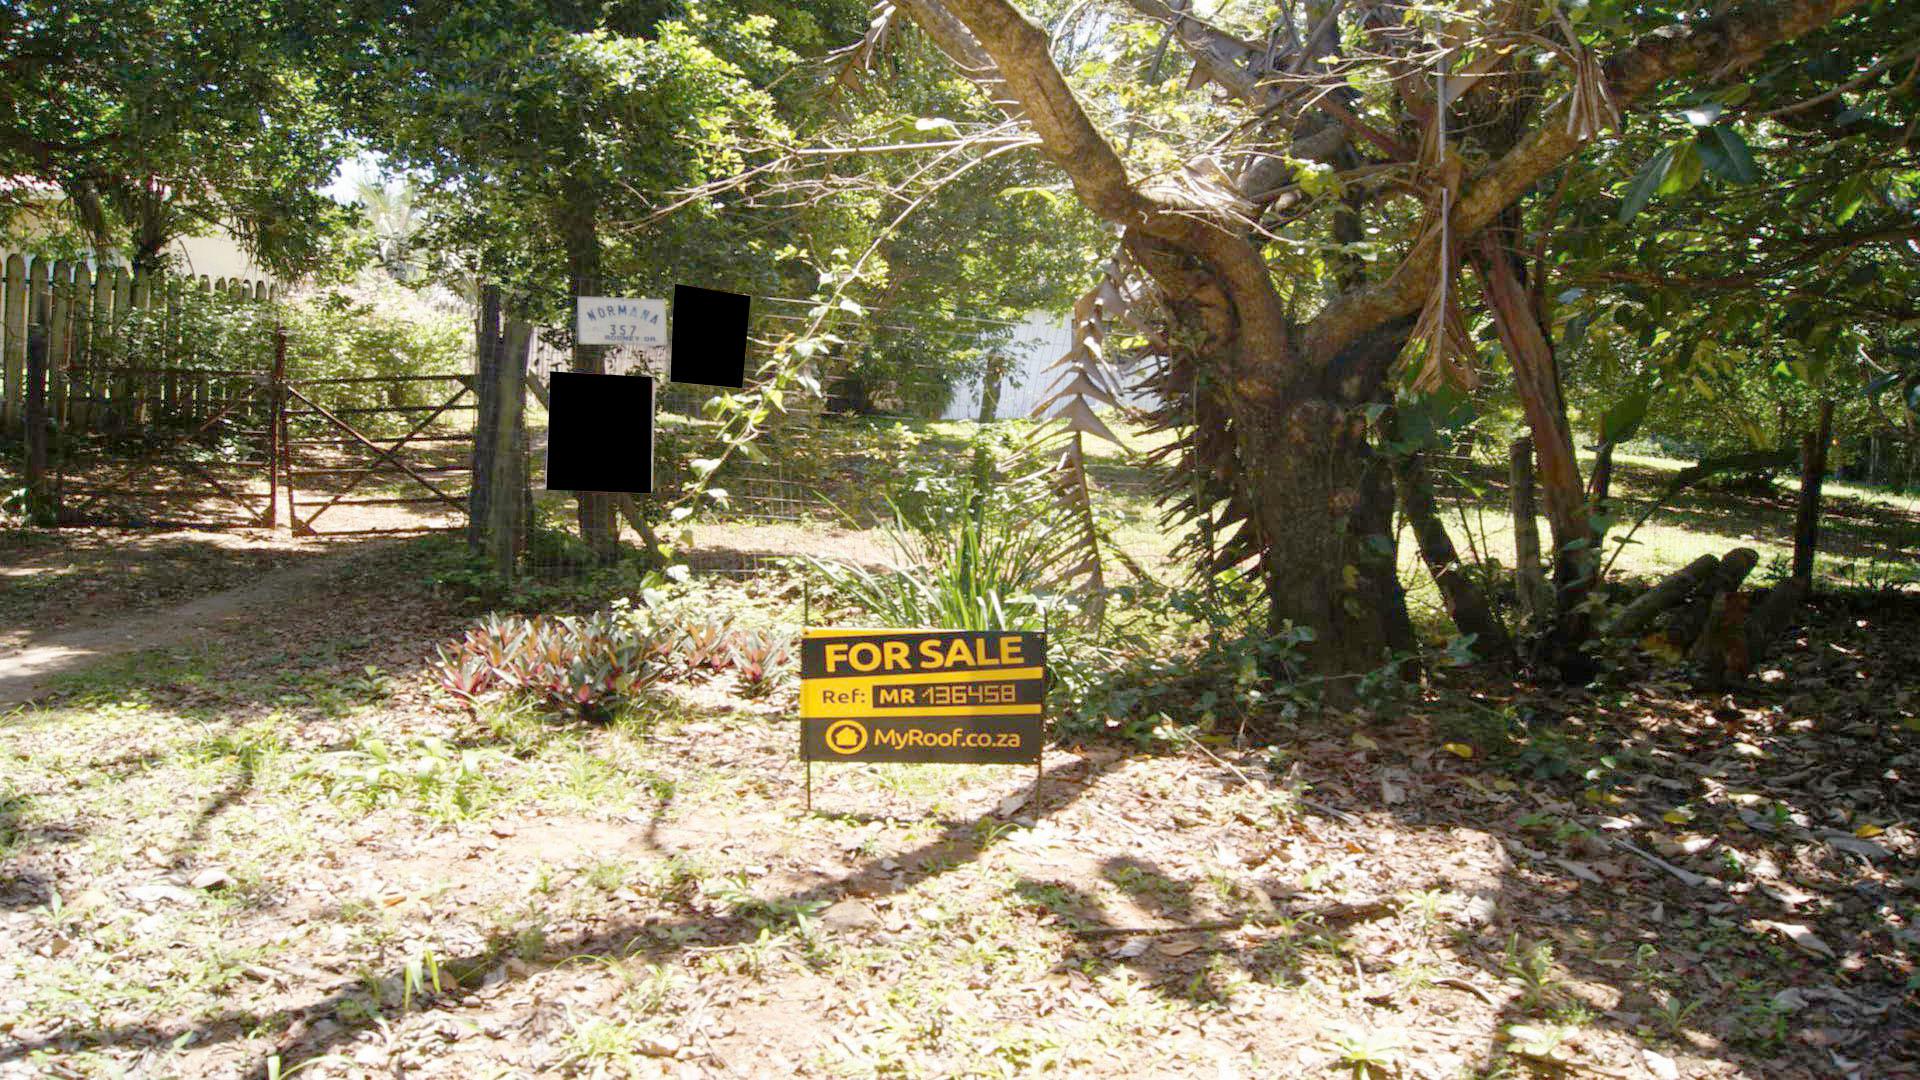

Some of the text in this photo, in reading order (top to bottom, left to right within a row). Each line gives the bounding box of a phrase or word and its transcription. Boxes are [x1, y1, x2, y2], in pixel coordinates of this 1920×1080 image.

[609, 324, 636, 336] 357
[825, 636, 1025, 672] FOR SALE
[822, 683, 1016, 704] Ref: MR 136458
[874, 727, 1021, 750] MyRoof.co.za
